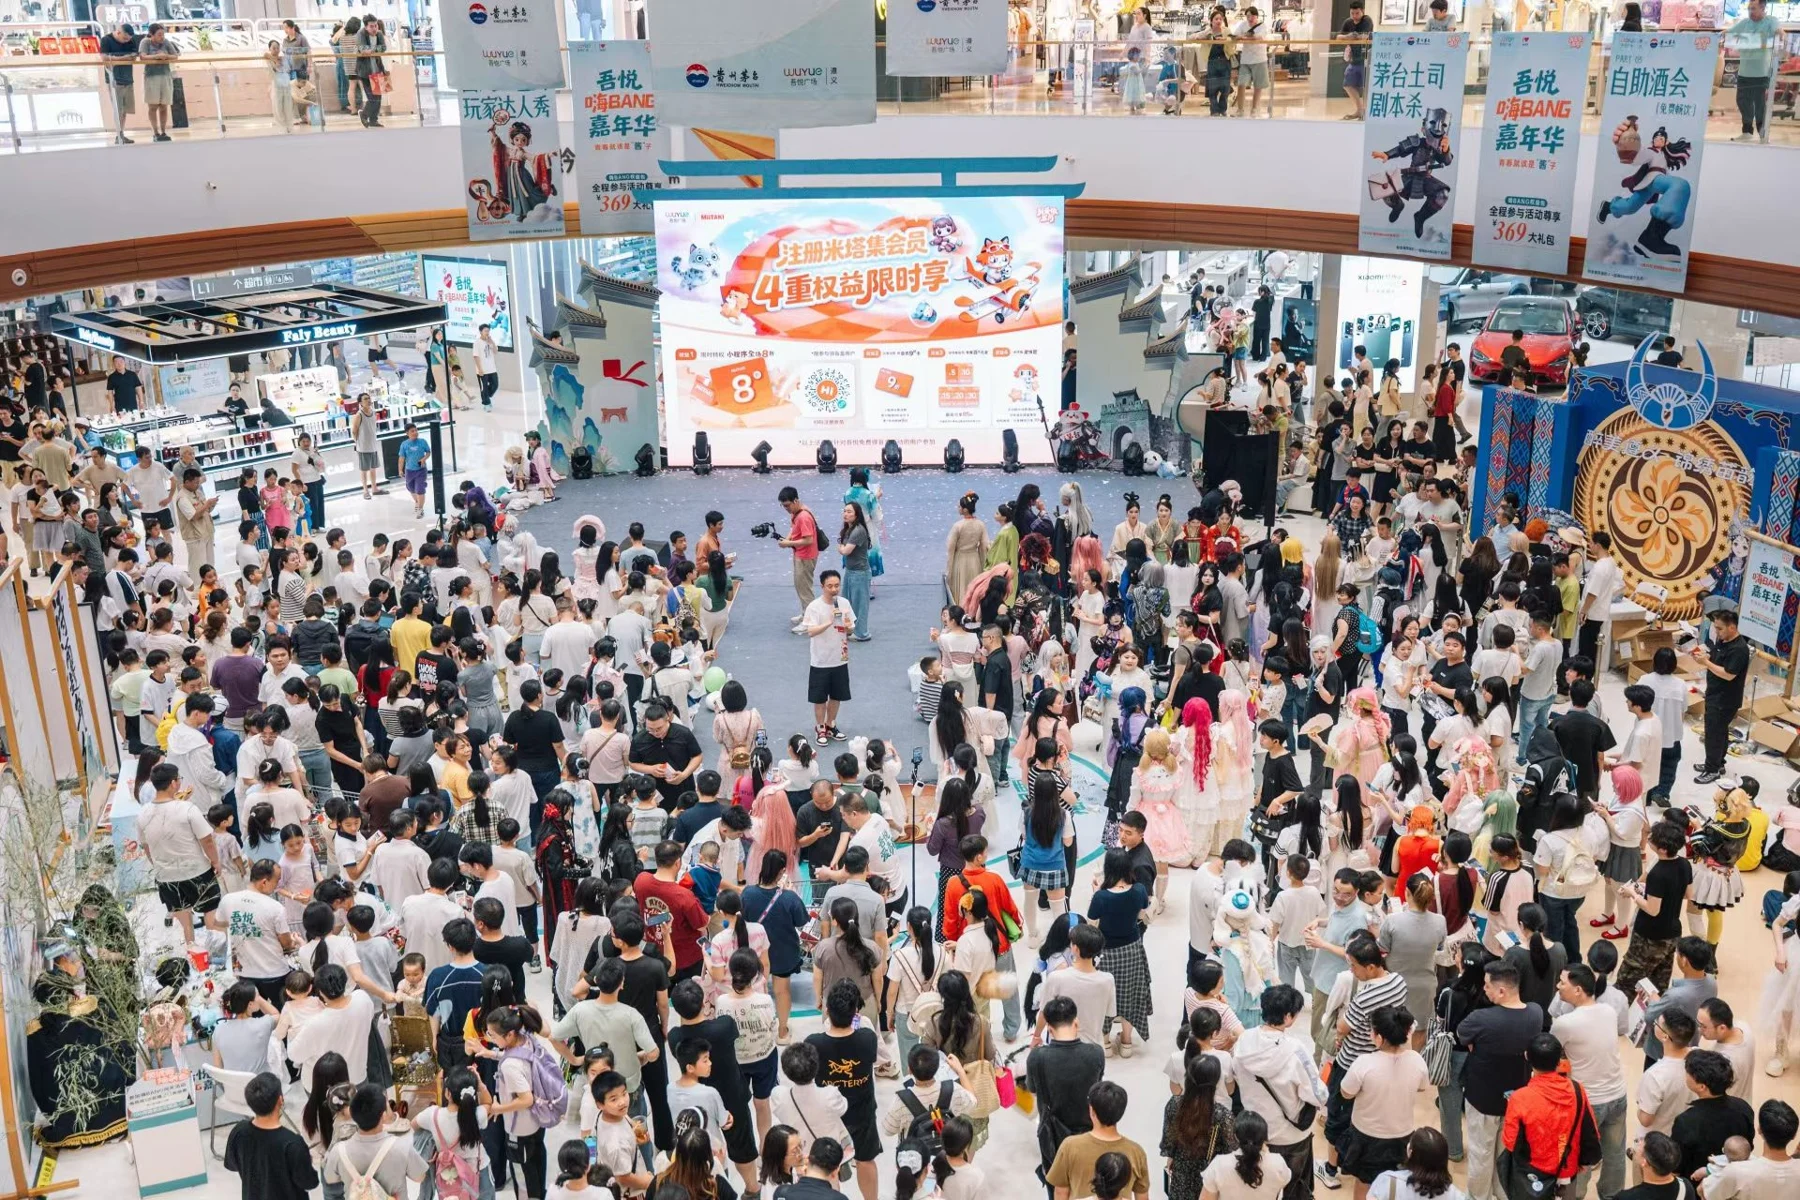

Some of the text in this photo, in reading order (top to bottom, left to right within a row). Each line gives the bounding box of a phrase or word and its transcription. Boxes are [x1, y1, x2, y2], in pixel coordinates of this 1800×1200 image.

[597, 69, 643, 92] 吾悦
[713, 67, 760, 83] 贵州茅台
[790, 79, 818, 87] 吾悦广场
[1373, 61, 1446, 91] 茅台土司
[1513, 69, 1561, 96] 吾悦
[1610, 66, 1691, 98] 自助酒会
[463, 95, 551, 121] 玩家达人秀
[1369, 91, 1423, 119] 剧本杀
[1496, 97, 1572, 122] 嗨BANG
[589, 114, 657, 138] 嘉年华
[1495, 123, 1565, 154] 嘉年华
[1489, 205, 1561, 223] 全程参与活动尊享
[775, 230, 929, 268] 注册米塔集会员
[1528, 232, 1555, 246] 大礼包
[244, 276, 263, 290] 超市
[455, 276, 473, 291] 吾悦
[754, 259, 950, 309] 4重权益限时享
[313, 324, 357, 339] Beauty
[731, 374, 756, 404] 8
[1760, 562, 1780, 579] 吾悦
[1751, 584, 1782, 606] 嘉年华
